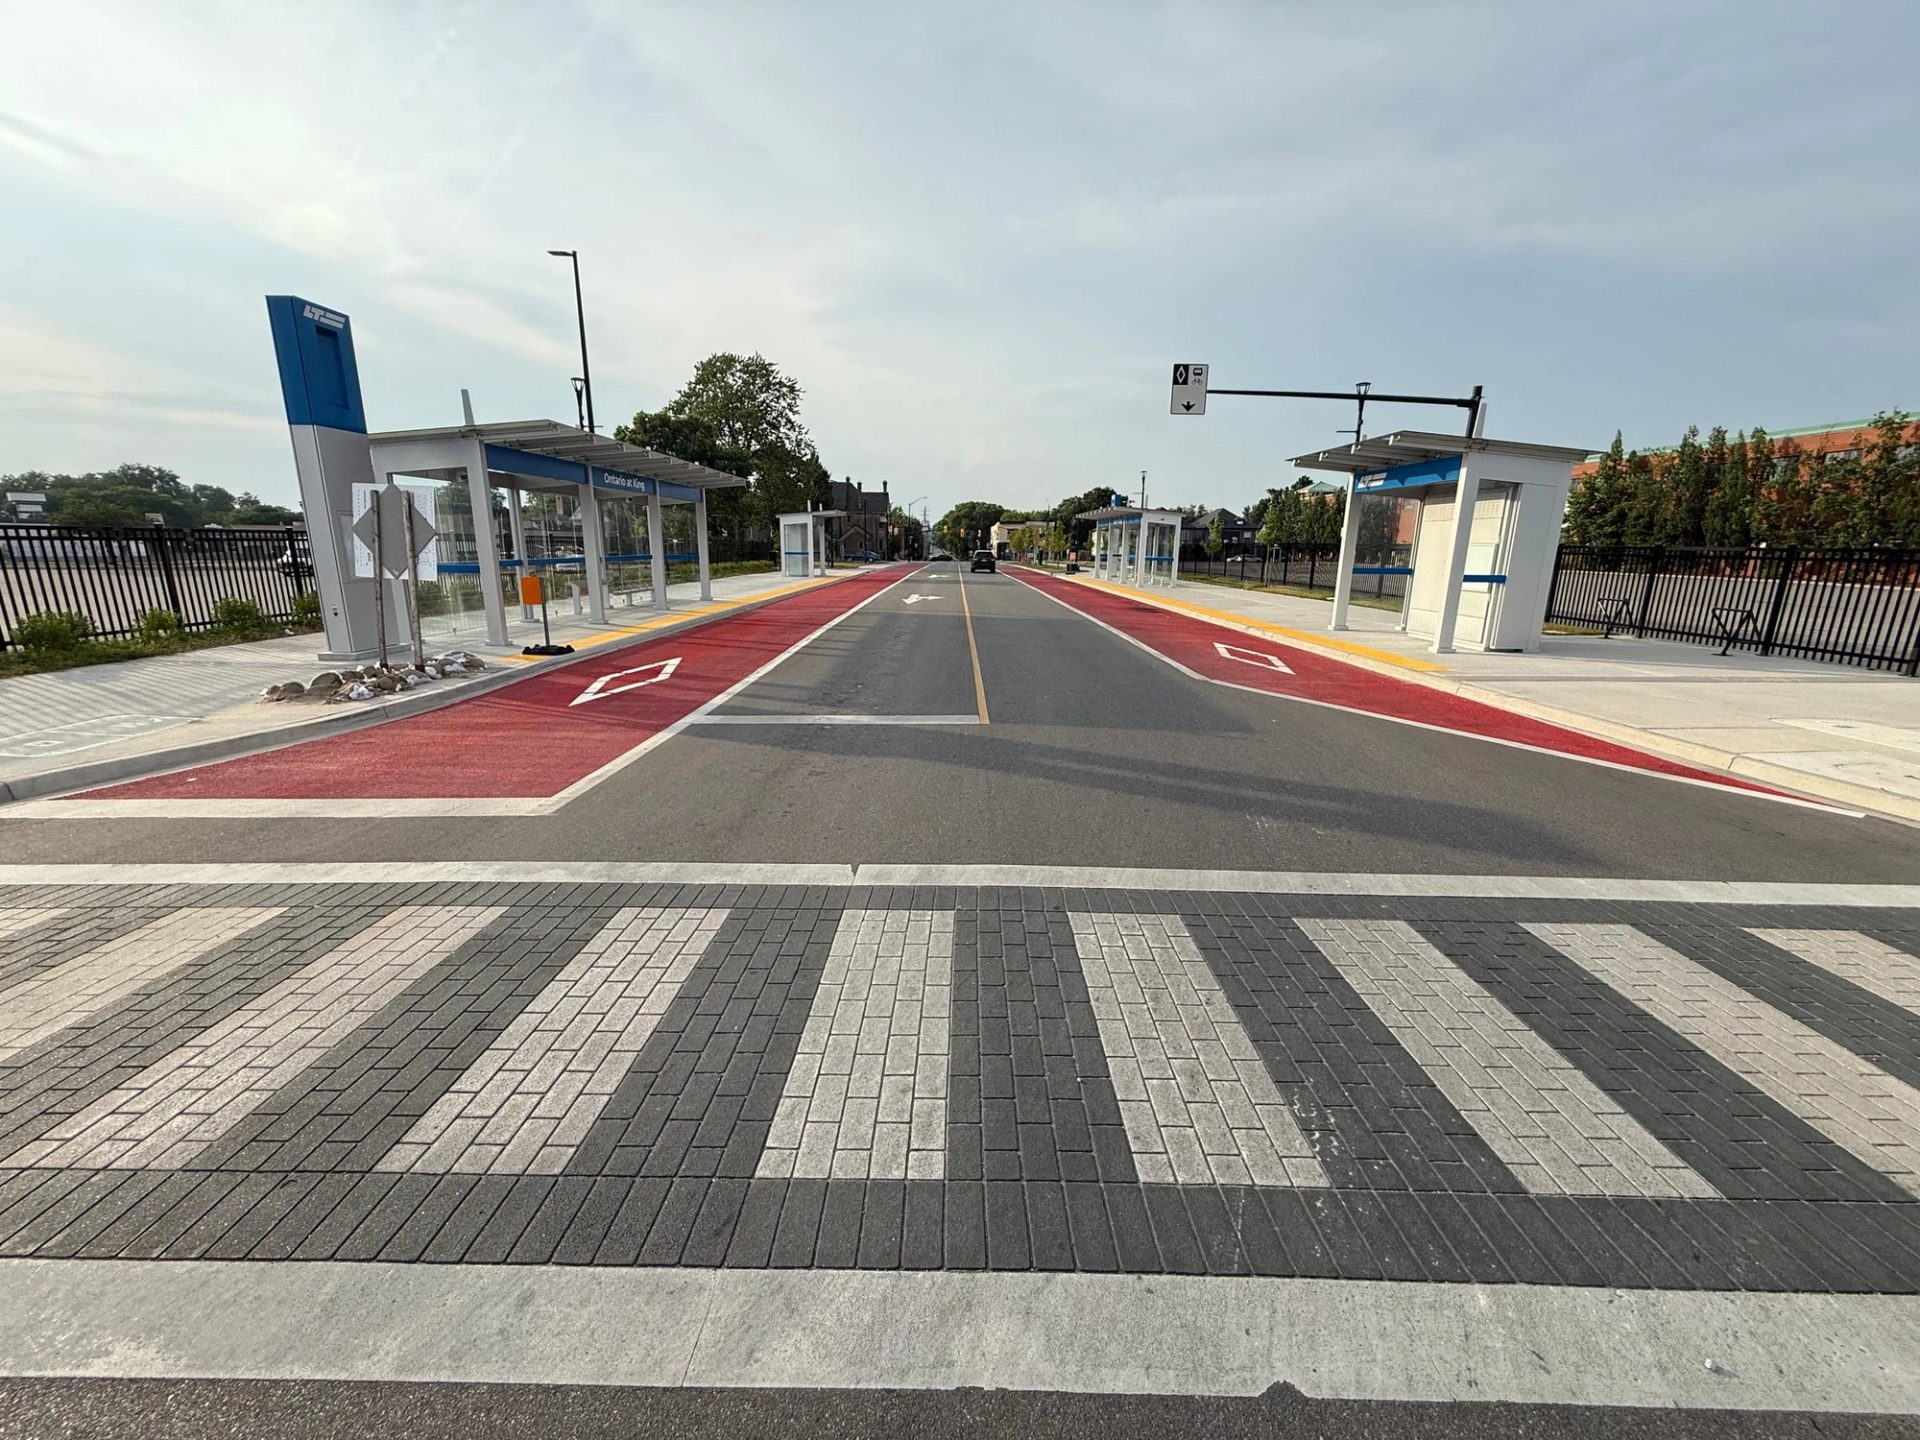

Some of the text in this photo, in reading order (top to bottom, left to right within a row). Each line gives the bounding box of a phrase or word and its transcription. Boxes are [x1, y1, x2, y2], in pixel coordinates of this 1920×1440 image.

[603, 472, 645, 492] Ontario at King
